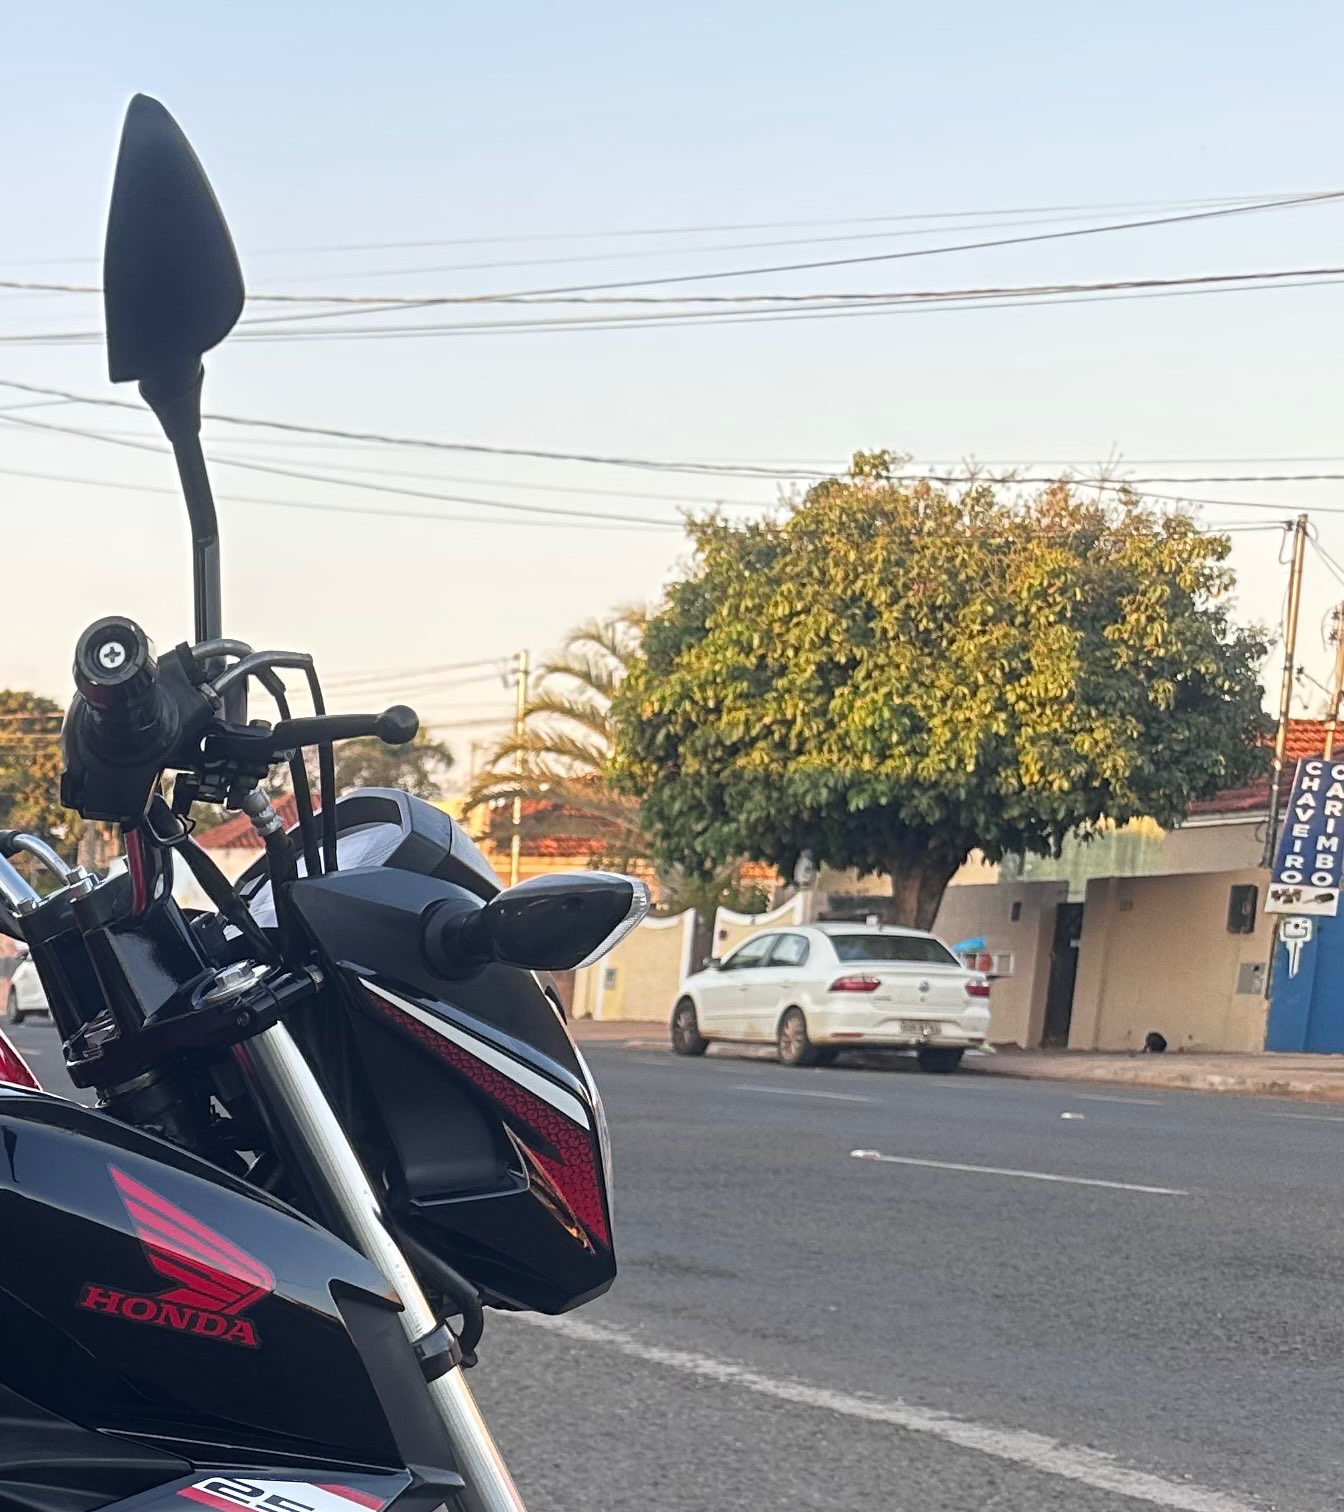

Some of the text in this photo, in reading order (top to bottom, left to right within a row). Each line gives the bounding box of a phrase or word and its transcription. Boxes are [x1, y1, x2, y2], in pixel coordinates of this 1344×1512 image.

[1280, 761, 1323, 884] CHAVEIRO
[1310, 764, 1344, 887] CARIMBO
[82, 1286, 258, 1347] HONDA
